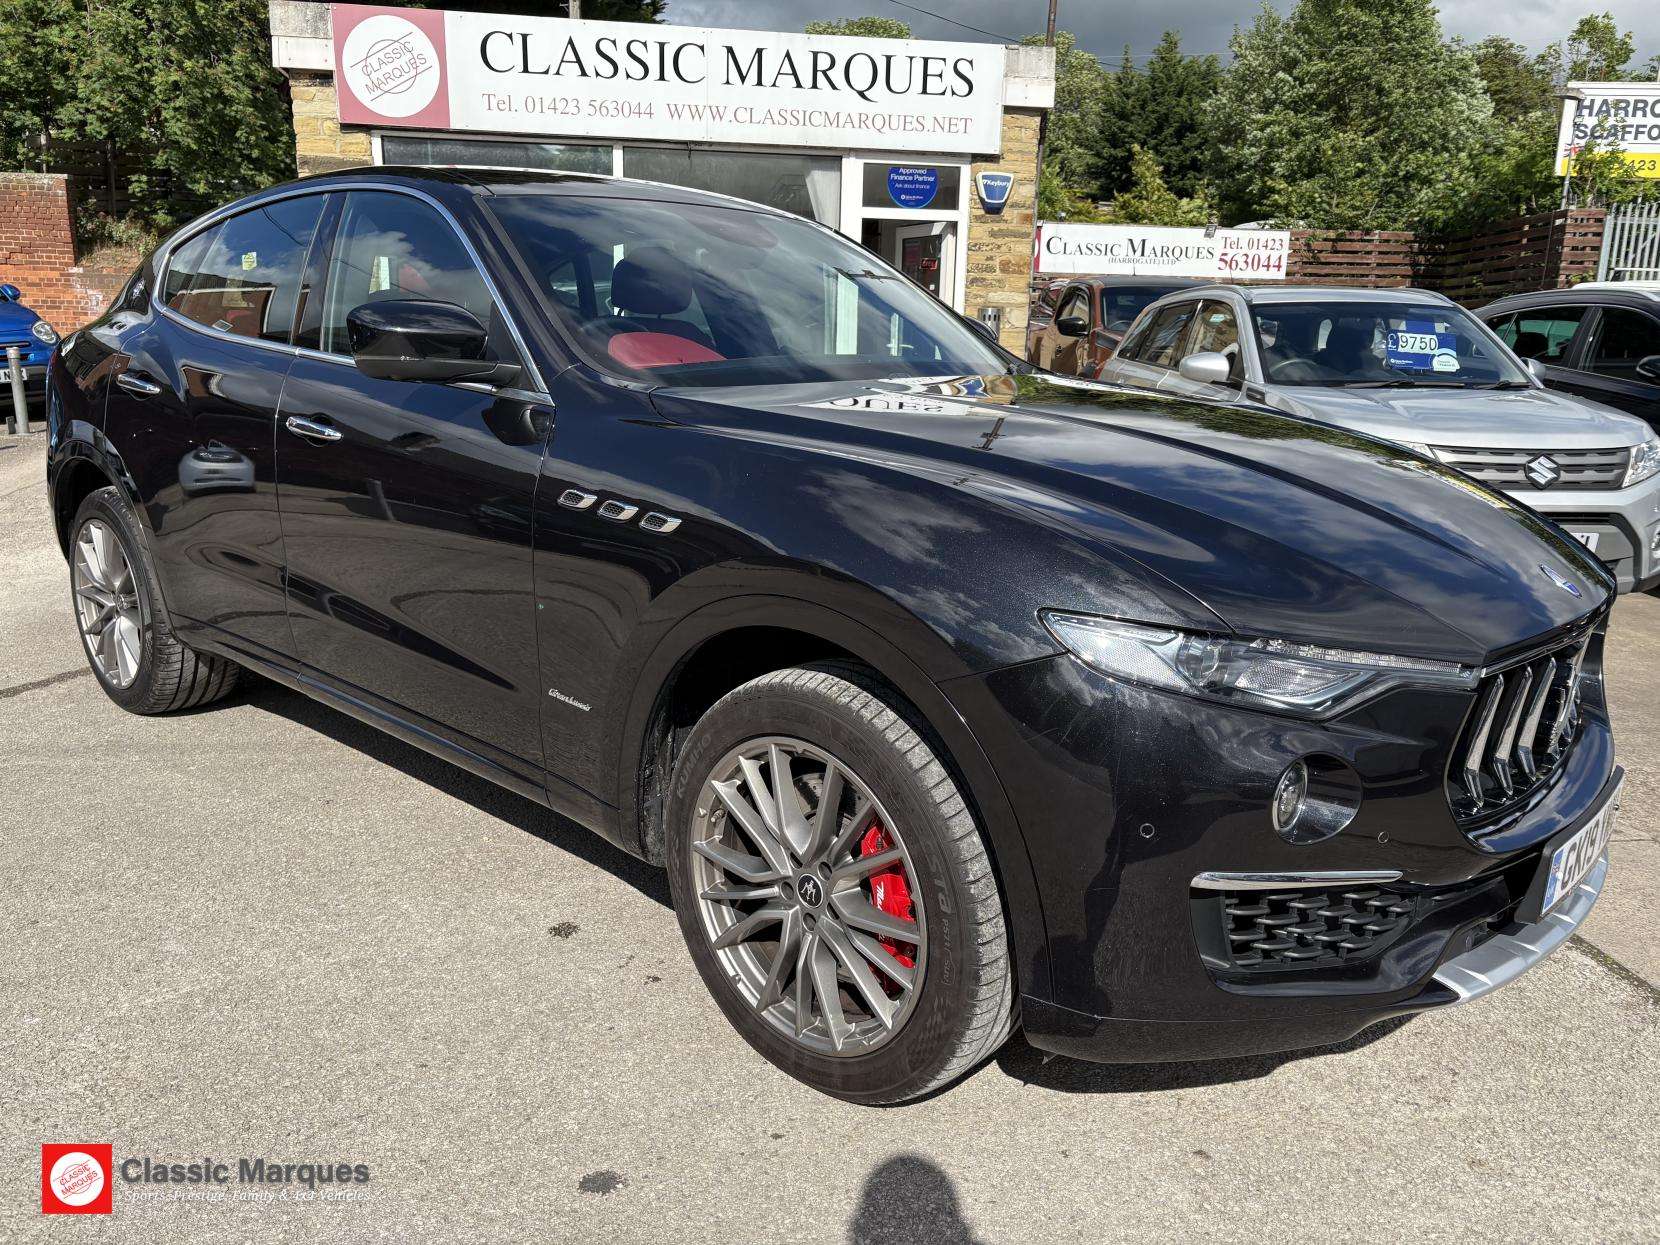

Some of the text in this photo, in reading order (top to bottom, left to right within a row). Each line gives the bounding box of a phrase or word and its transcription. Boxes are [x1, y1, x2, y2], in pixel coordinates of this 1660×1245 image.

[361, 41, 414, 77] CLASSIC
[480, 30, 974, 103] CLASSIC MARQUES
[365, 53, 427, 95] MARQUES
[482, 92, 973, 135] Tel. 01423 563044 WWW.CLASSICMARQUES.NET
[890, 173, 935, 182] Finance Partner
[899, 167, 927, 175] Approved
[1222, 236, 1284, 251] Tel. 01423
[1217, 252, 1283, 273] 563044
